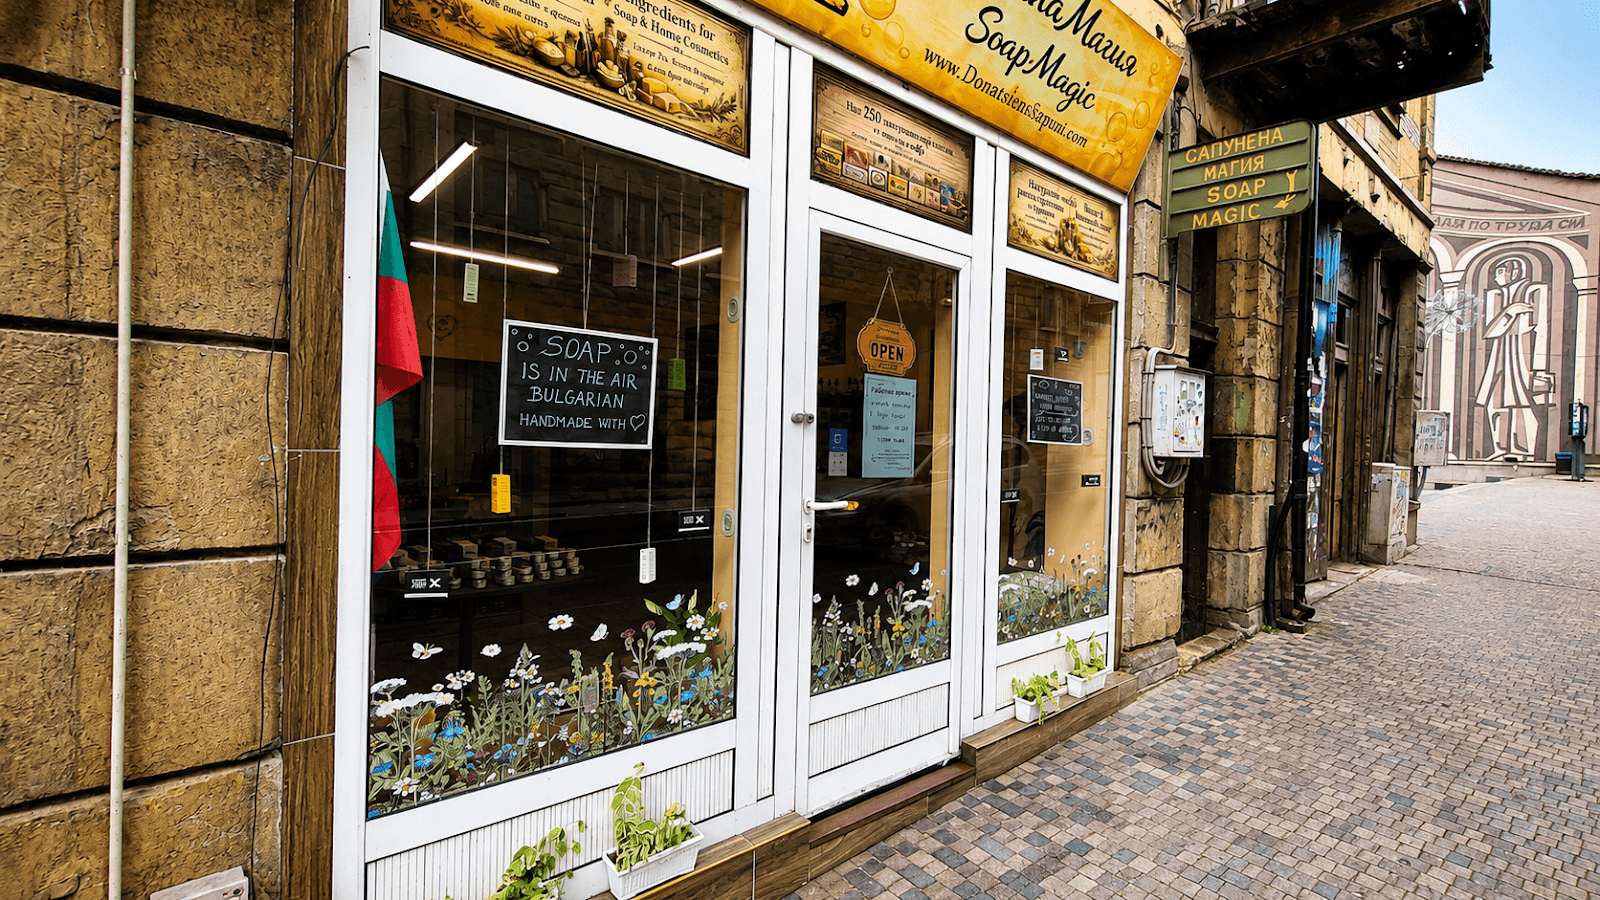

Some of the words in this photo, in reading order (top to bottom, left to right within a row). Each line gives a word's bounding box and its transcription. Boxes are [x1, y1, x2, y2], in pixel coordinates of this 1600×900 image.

[613, 4, 638, 27] Soap
[640, 15, 648, 29] &
[625, 0, 697, 33] ngredients
[699, 23, 716, 42] for
[1053, 0, 1138, 77] Магия
[965, 6, 1031, 76] Soap
[1021, 43, 1096, 113] Magic
[863, 105, 882, 124] 250
[1185, 127, 1283, 163] САПУНЕНА
[1204, 155, 1265, 181] МАГИЯ
[1207, 178, 1266, 203] SOAP
[1192, 203, 1261, 229] MAGIC
[1468, 220, 1491, 231] ПО
[537, 335, 612, 364] SOAP
[871, 342, 904, 362] OPEN
[522, 362, 541, 380] IS
[549, 366, 569, 383] IN
[577, 368, 606, 386] THE
[609, 372, 638, 390] AIR
[527, 386, 624, 409] BULGARIAN
[519, 412, 593, 429] HANDMADE
[598, 417, 626, 430] WITH
